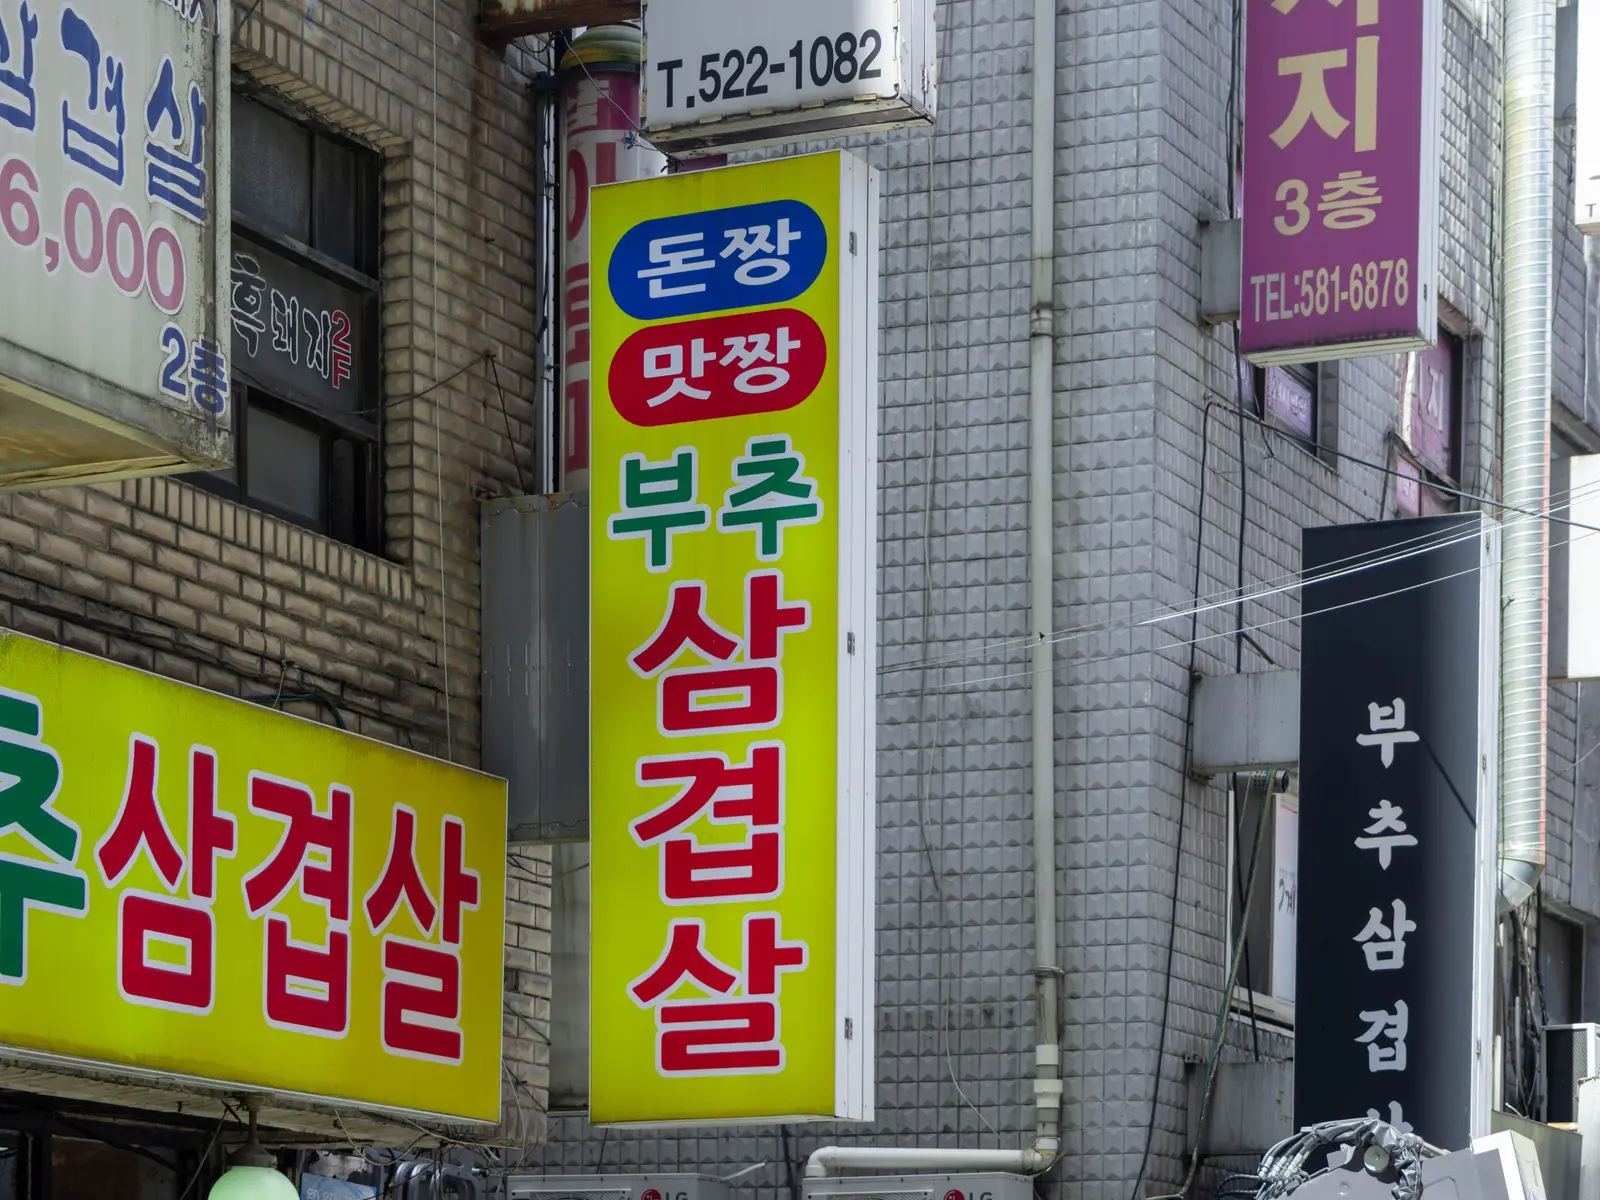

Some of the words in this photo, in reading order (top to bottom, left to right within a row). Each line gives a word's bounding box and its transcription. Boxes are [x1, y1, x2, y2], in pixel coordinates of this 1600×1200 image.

[657, 28, 883, 109] T.522-1082
[1268, 0, 1380, 153] 지
[0, 158, 184, 311] 6,000
[1274, 170, 1382, 236] 3층
[637, 218, 802, 299] 돈짱
[1250, 259, 1409, 323] TEL:581-6878
[159, 325, 229, 413] 2층
[331, 309, 351, 389] 2F
[643, 327, 802, 408] 맛짱
[609, 435, 821, 569] 부추
[627, 570, 808, 1075] 삼겹살
